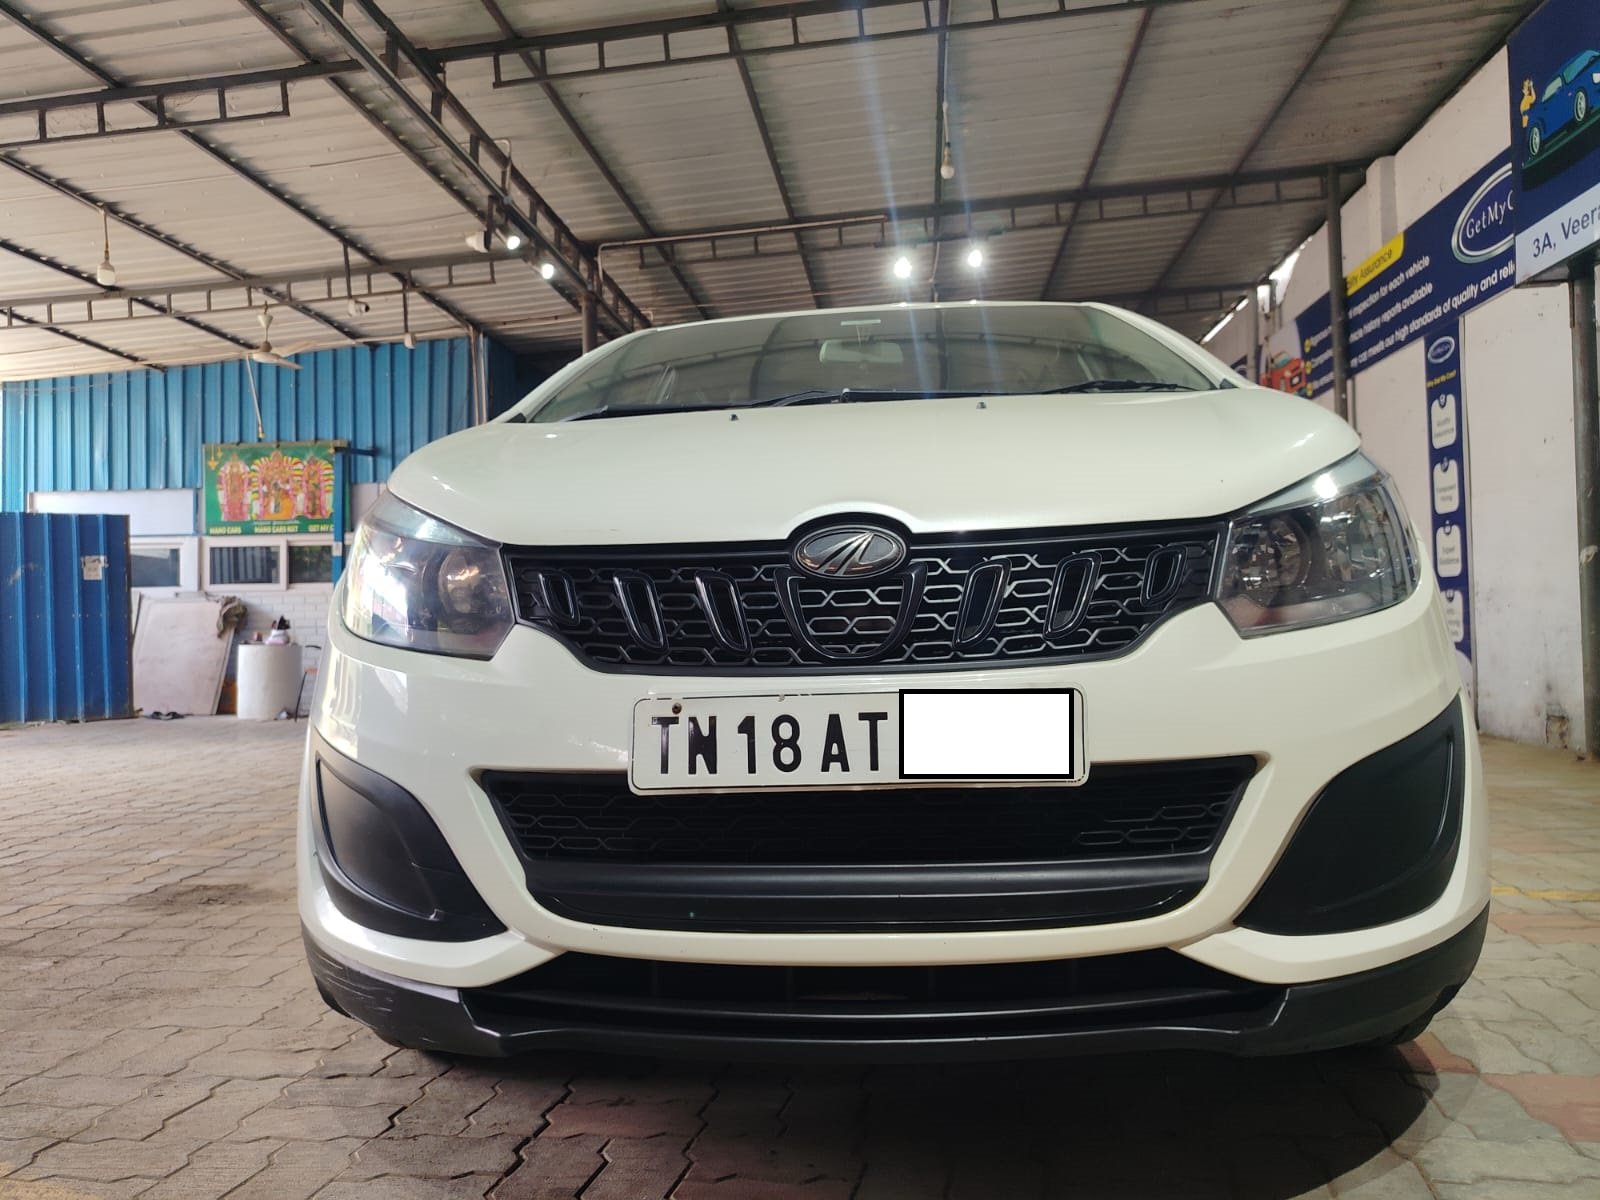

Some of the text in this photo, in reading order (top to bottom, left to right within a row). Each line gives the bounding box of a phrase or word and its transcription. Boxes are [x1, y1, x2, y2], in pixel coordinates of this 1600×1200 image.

[1532, 204, 1600, 258] 3A, Veer
[1388, 272, 1405, 292] each
[1405, 255, 1430, 279] vehicle
[1401, 283, 1433, 310] available
[1408, 305, 1442, 333] standards
[1442, 298, 1451, 313] of
[1451, 282, 1478, 309] quality
[1479, 269, 1498, 291] and
[651, 711, 889, 775] TN 18 AT
